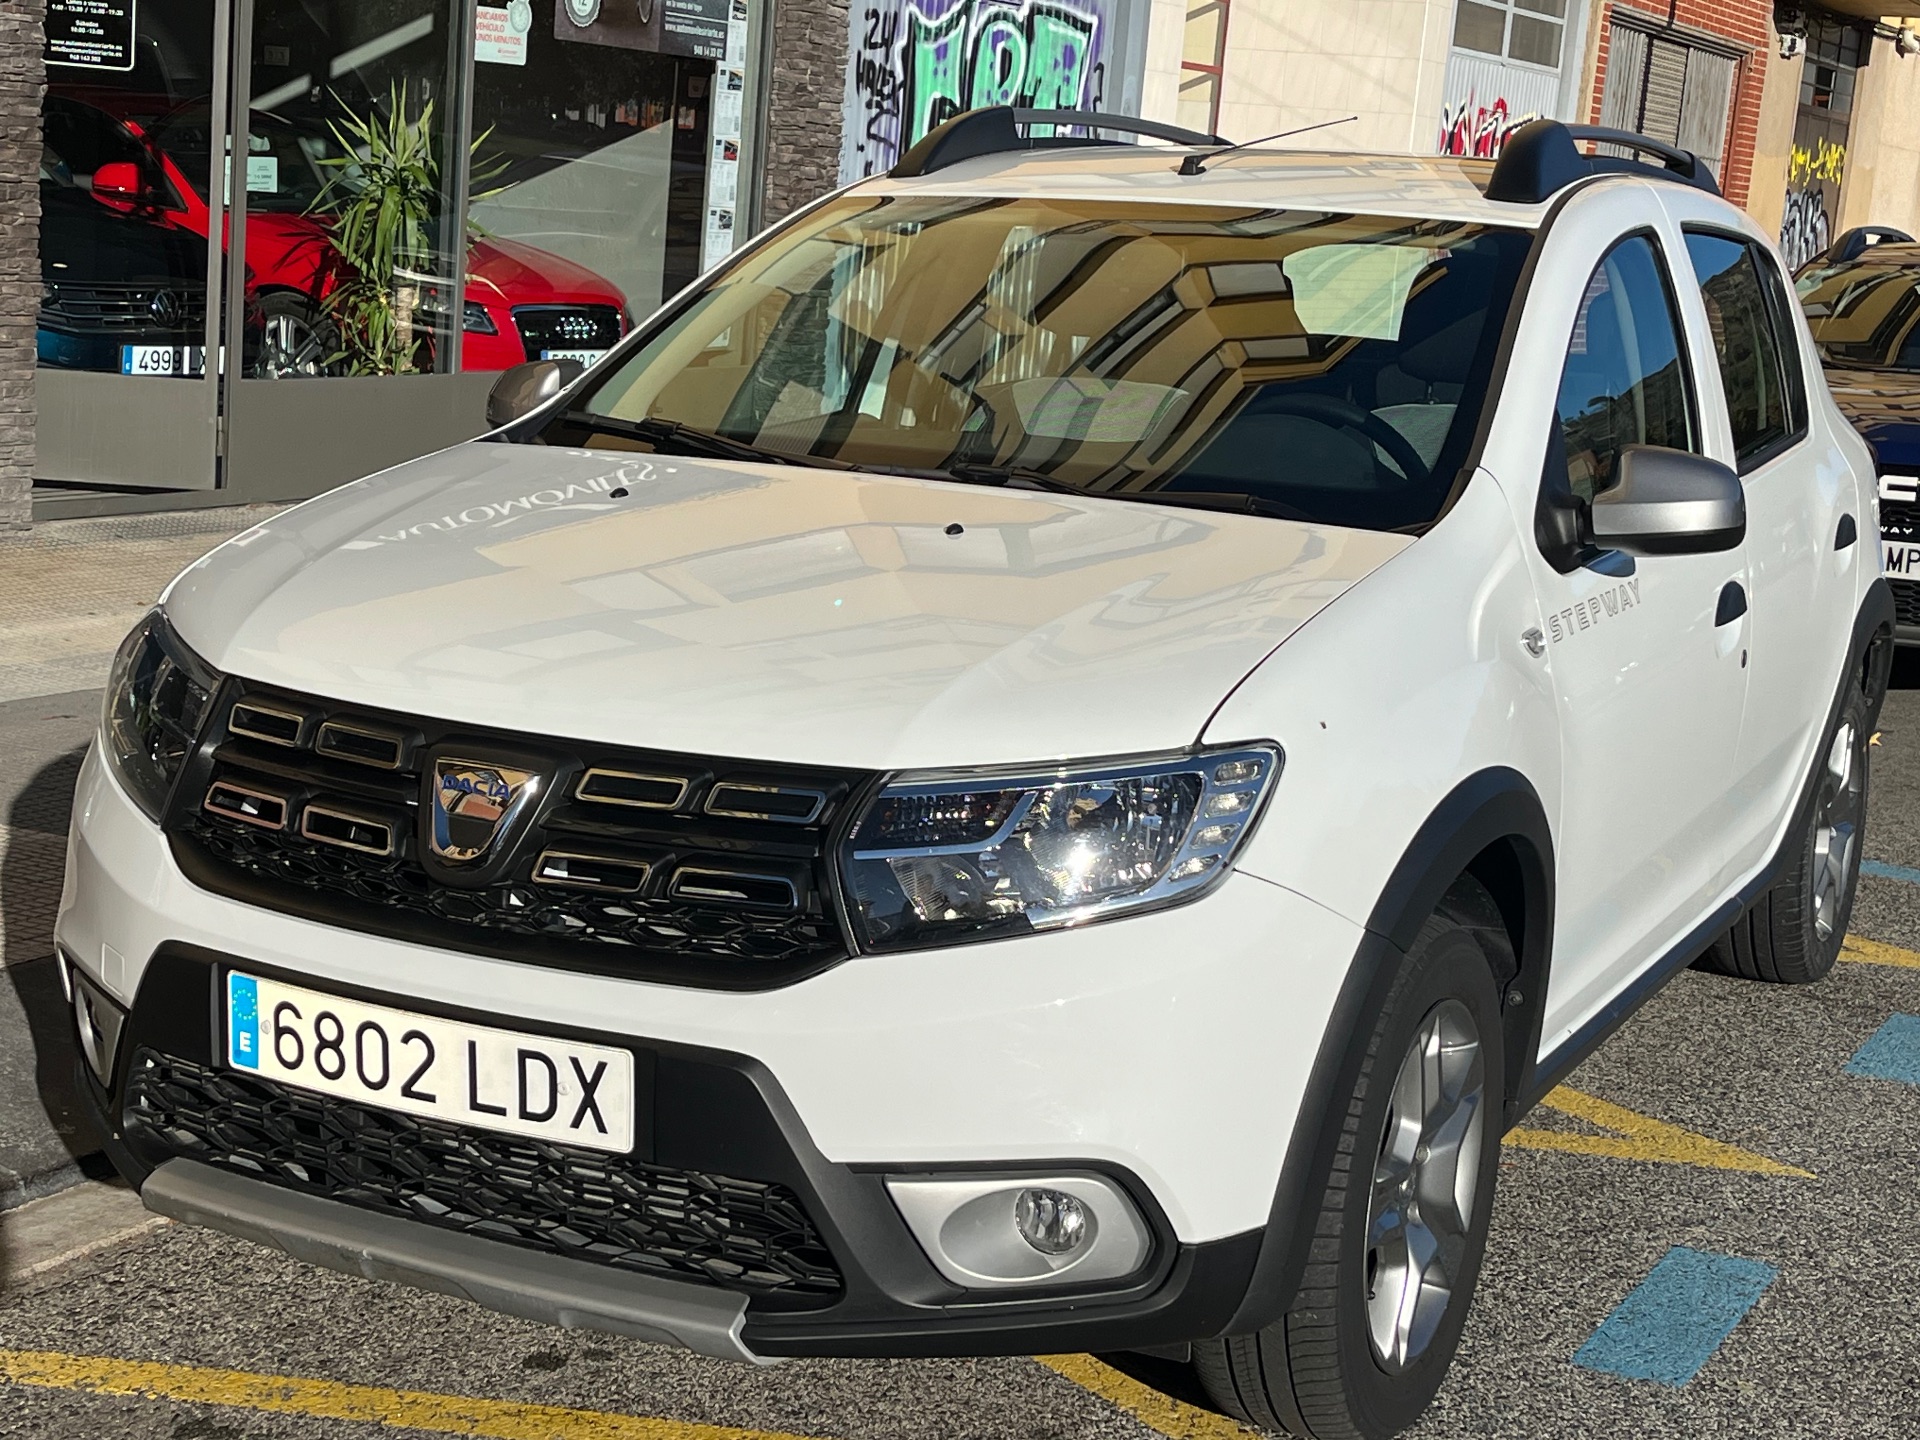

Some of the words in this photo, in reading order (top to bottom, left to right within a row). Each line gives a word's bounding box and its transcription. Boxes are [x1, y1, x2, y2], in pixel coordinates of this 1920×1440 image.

[139, 350, 181, 371] 4999
[1886, 546, 1920, 573] MP
[1549, 577, 1640, 643] STEPWAY
[442, 774, 511, 800] DACIA
[239, 1031, 252, 1053] E
[273, 1000, 437, 1104] 6802
[467, 1039, 609, 1134] LDX
